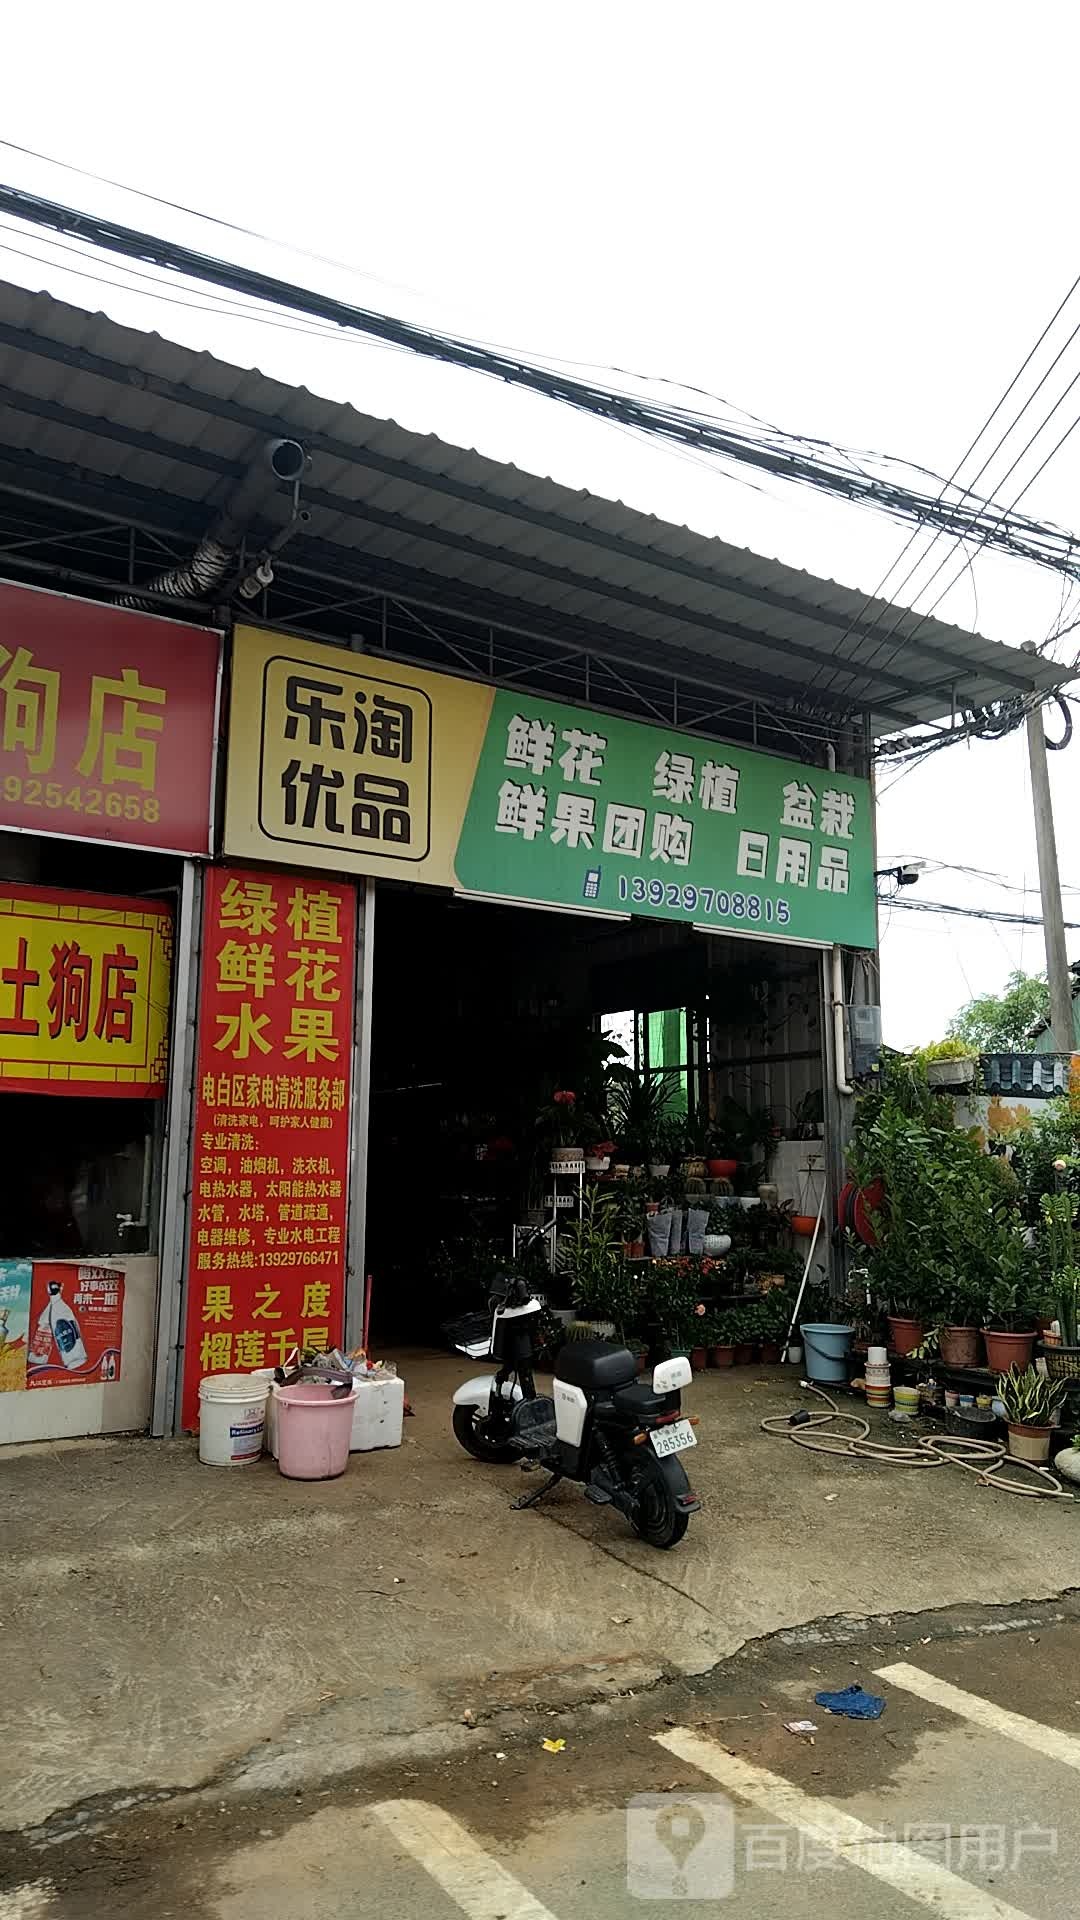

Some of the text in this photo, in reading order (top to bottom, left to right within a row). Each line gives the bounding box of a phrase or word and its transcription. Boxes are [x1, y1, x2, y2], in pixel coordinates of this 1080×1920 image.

[284, 675, 413, 764] 乐淘
[281, 759, 411, 844] 优品
[503, 713, 856, 840] 鲜花 绿植 盆栽
[494, 779, 850, 894] 鲜果团购 日用品
[219, 879, 342, 943] 绿植
[618, 874, 791, 925] 13929708815
[0, 936, 138, 1044] 土狗店
[216, 940, 341, 1002] 鲜花
[213, 1003, 339, 1063] 水果
[203, 1072, 345, 1111] 电白区家电清洗服务部
[656, 1431, 694, 1454] 285356
